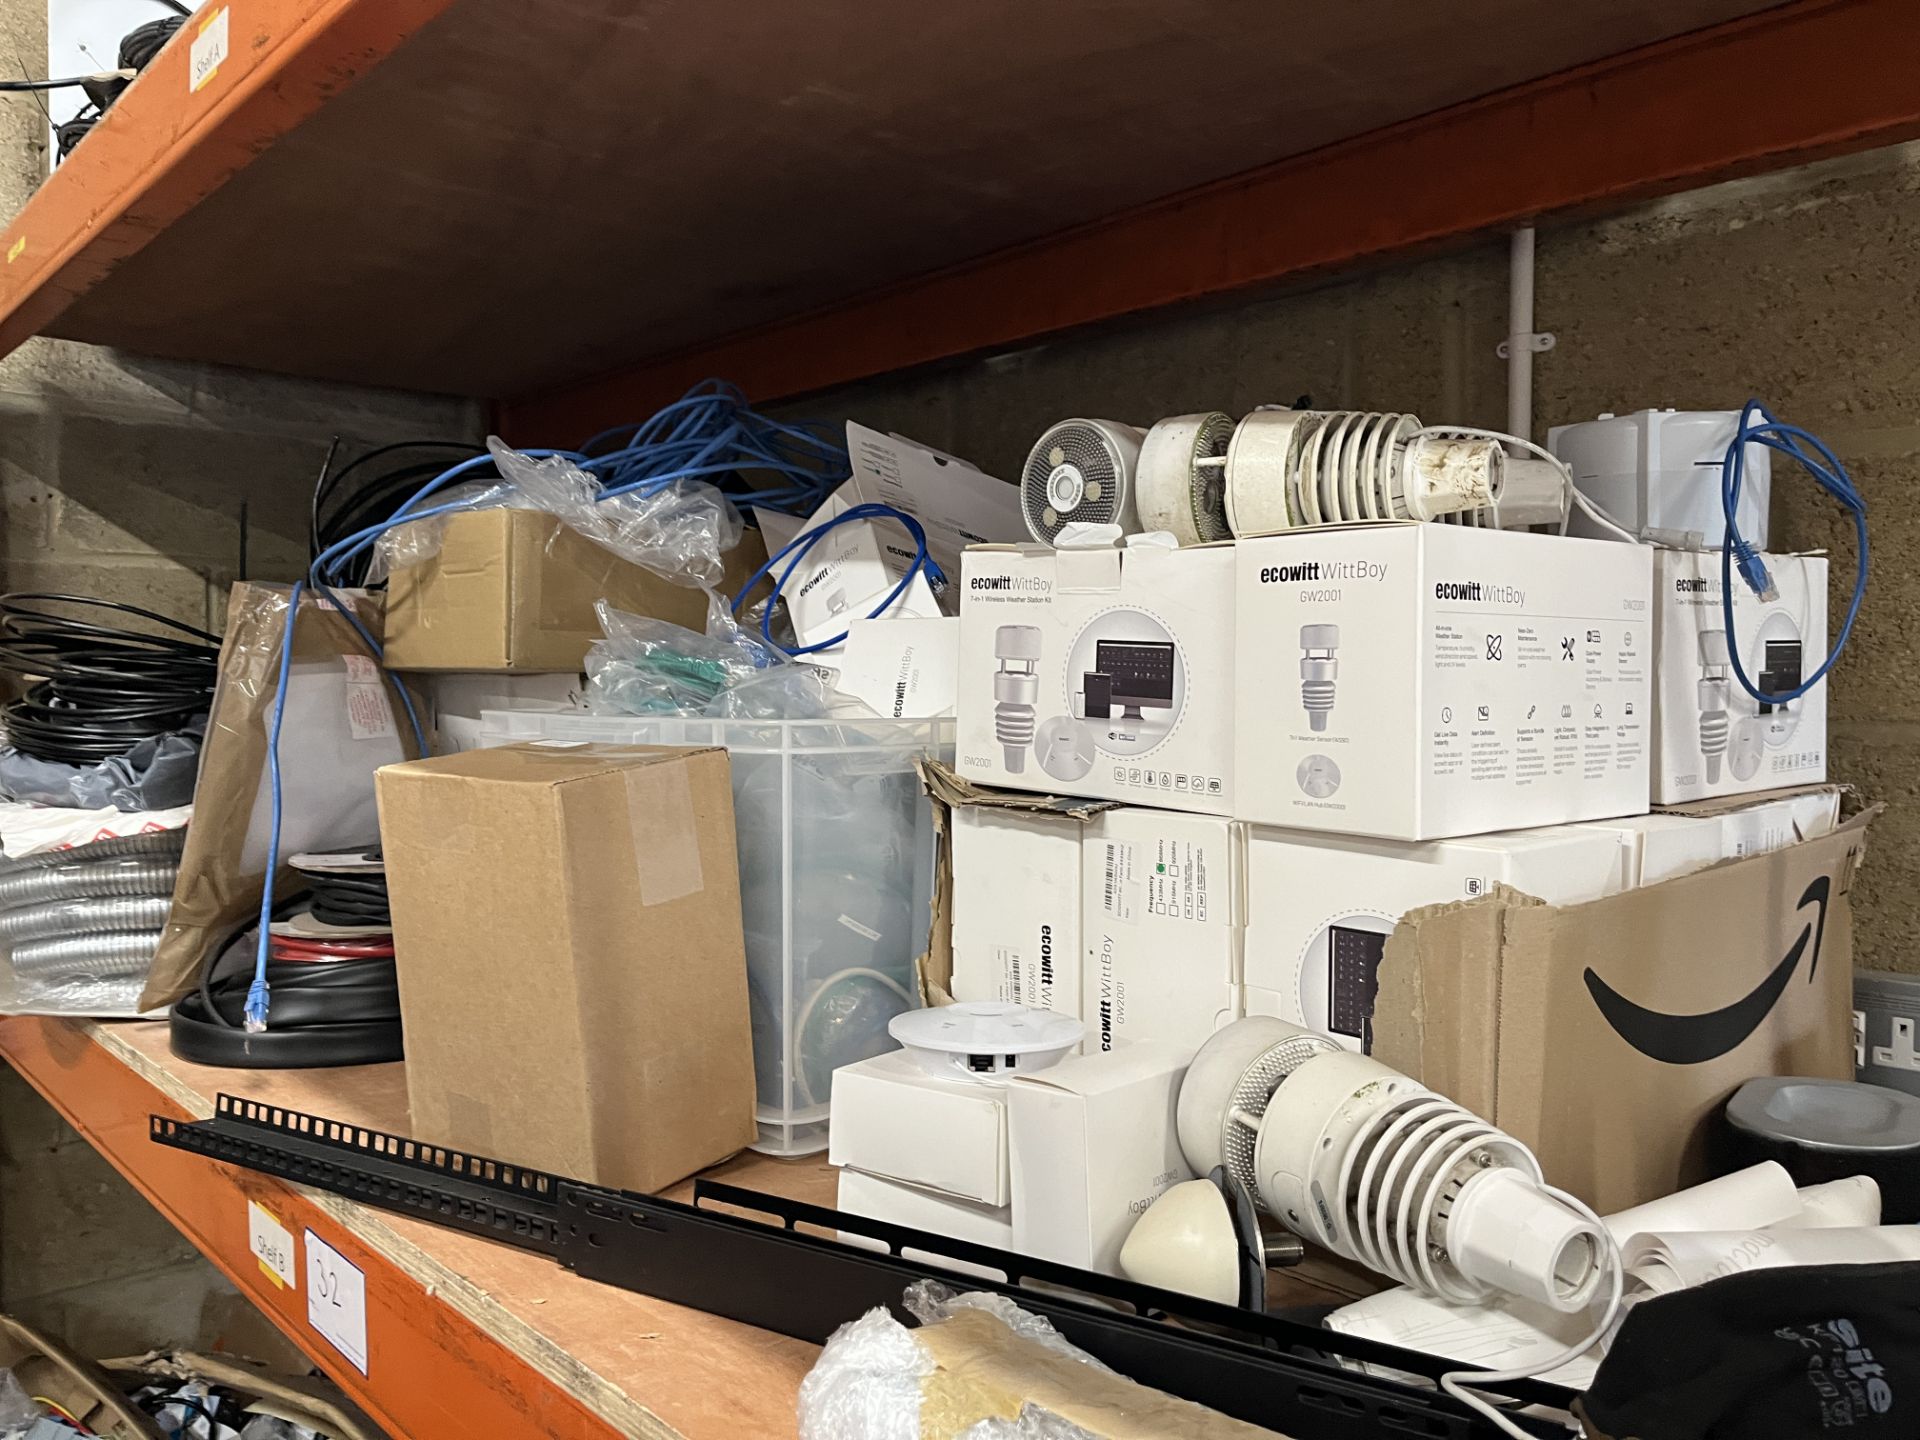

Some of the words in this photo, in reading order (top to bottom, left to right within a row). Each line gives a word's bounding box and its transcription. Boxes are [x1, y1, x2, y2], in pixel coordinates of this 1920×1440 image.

[800, 566, 829, 597] ecowitt
[827, 544, 860, 576] WittBoy
[970, 575, 1011, 590] ecowitt
[1011, 576, 1053, 594] WittBoy
[1260, 562, 1320, 583] ecowitt
[1320, 560, 1388, 581] WittBoy
[1676, 577, 1707, 592] ecowitt
[1299, 589, 1342, 603] GW2001
[1435, 581, 1481, 601] ecowitt
[1481, 585, 1526, 607] WittBoy
[899, 646, 915, 682] WittBoy
[893, 681, 907, 718] ecowitt
[964, 755, 992, 769] GW2001
[1041, 925, 1053, 985] ecowitt
[1101, 934, 1114, 999] WittBoy
[1028, 963, 1037, 1004] GW2001
[1116, 981, 1126, 1025] GW2001
[1100, 999, 1112, 1052] cowitt
[279, 1252, 285, 1273] B
[316, 1258, 342, 1308] 32
